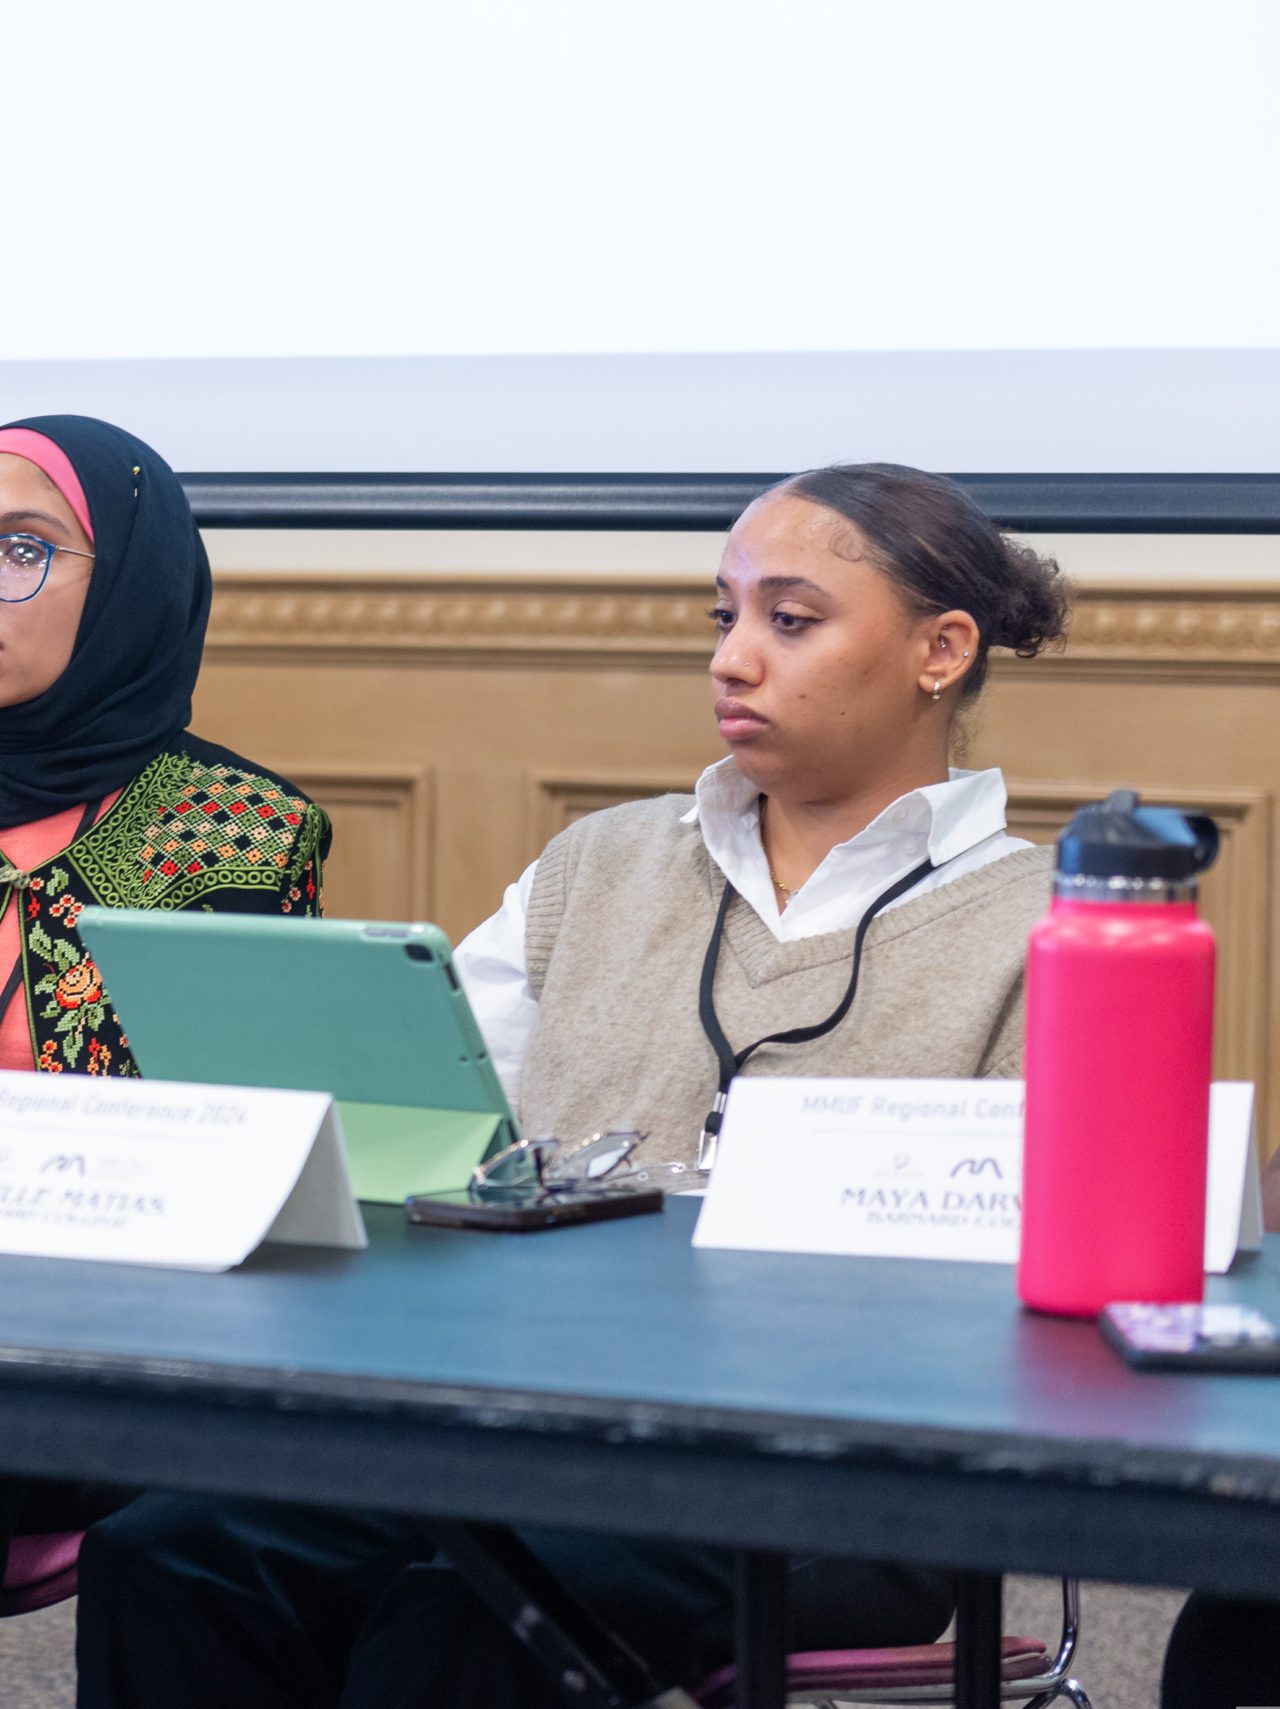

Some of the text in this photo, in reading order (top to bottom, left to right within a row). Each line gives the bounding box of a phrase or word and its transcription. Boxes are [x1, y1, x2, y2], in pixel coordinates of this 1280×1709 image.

[81, 1093, 193, 1122] Conference
[870, 1096, 967, 1122] Regional
[974, 1098, 1025, 1118] Conf
[840, 1187, 929, 1209] MAYA
[866, 1211, 969, 1226] BARNARD
